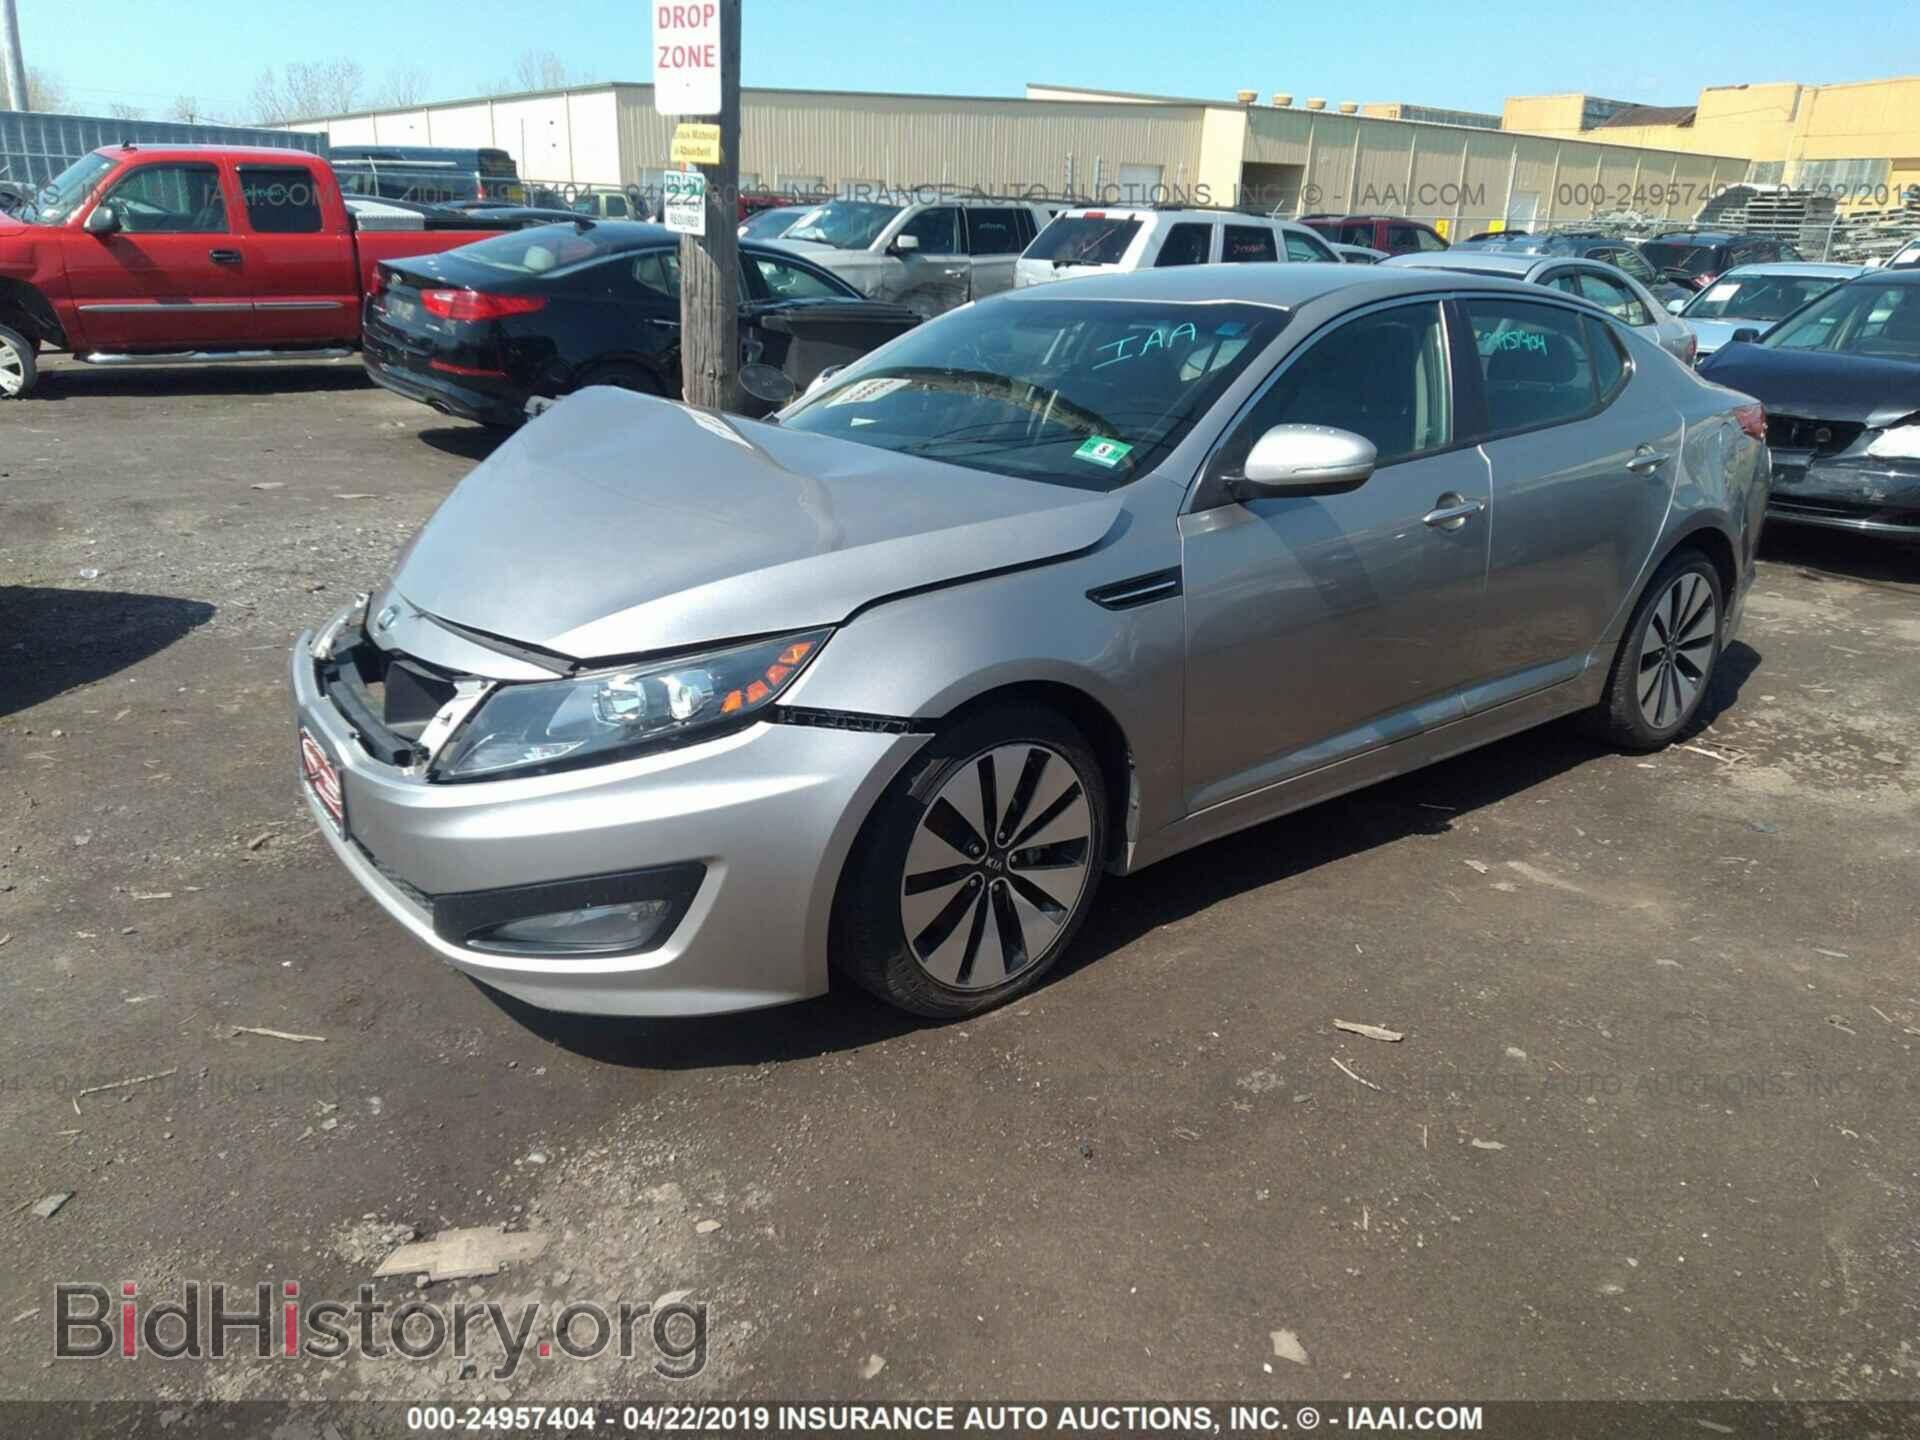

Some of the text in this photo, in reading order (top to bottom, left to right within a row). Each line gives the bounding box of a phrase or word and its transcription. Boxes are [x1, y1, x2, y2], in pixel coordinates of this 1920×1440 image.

[658, 4, 715, 29] DROP
[658, 45, 715, 68] ZONE
[1092, 322, 1196, 370] IAA
[985, 857, 1003, 872] KIA
